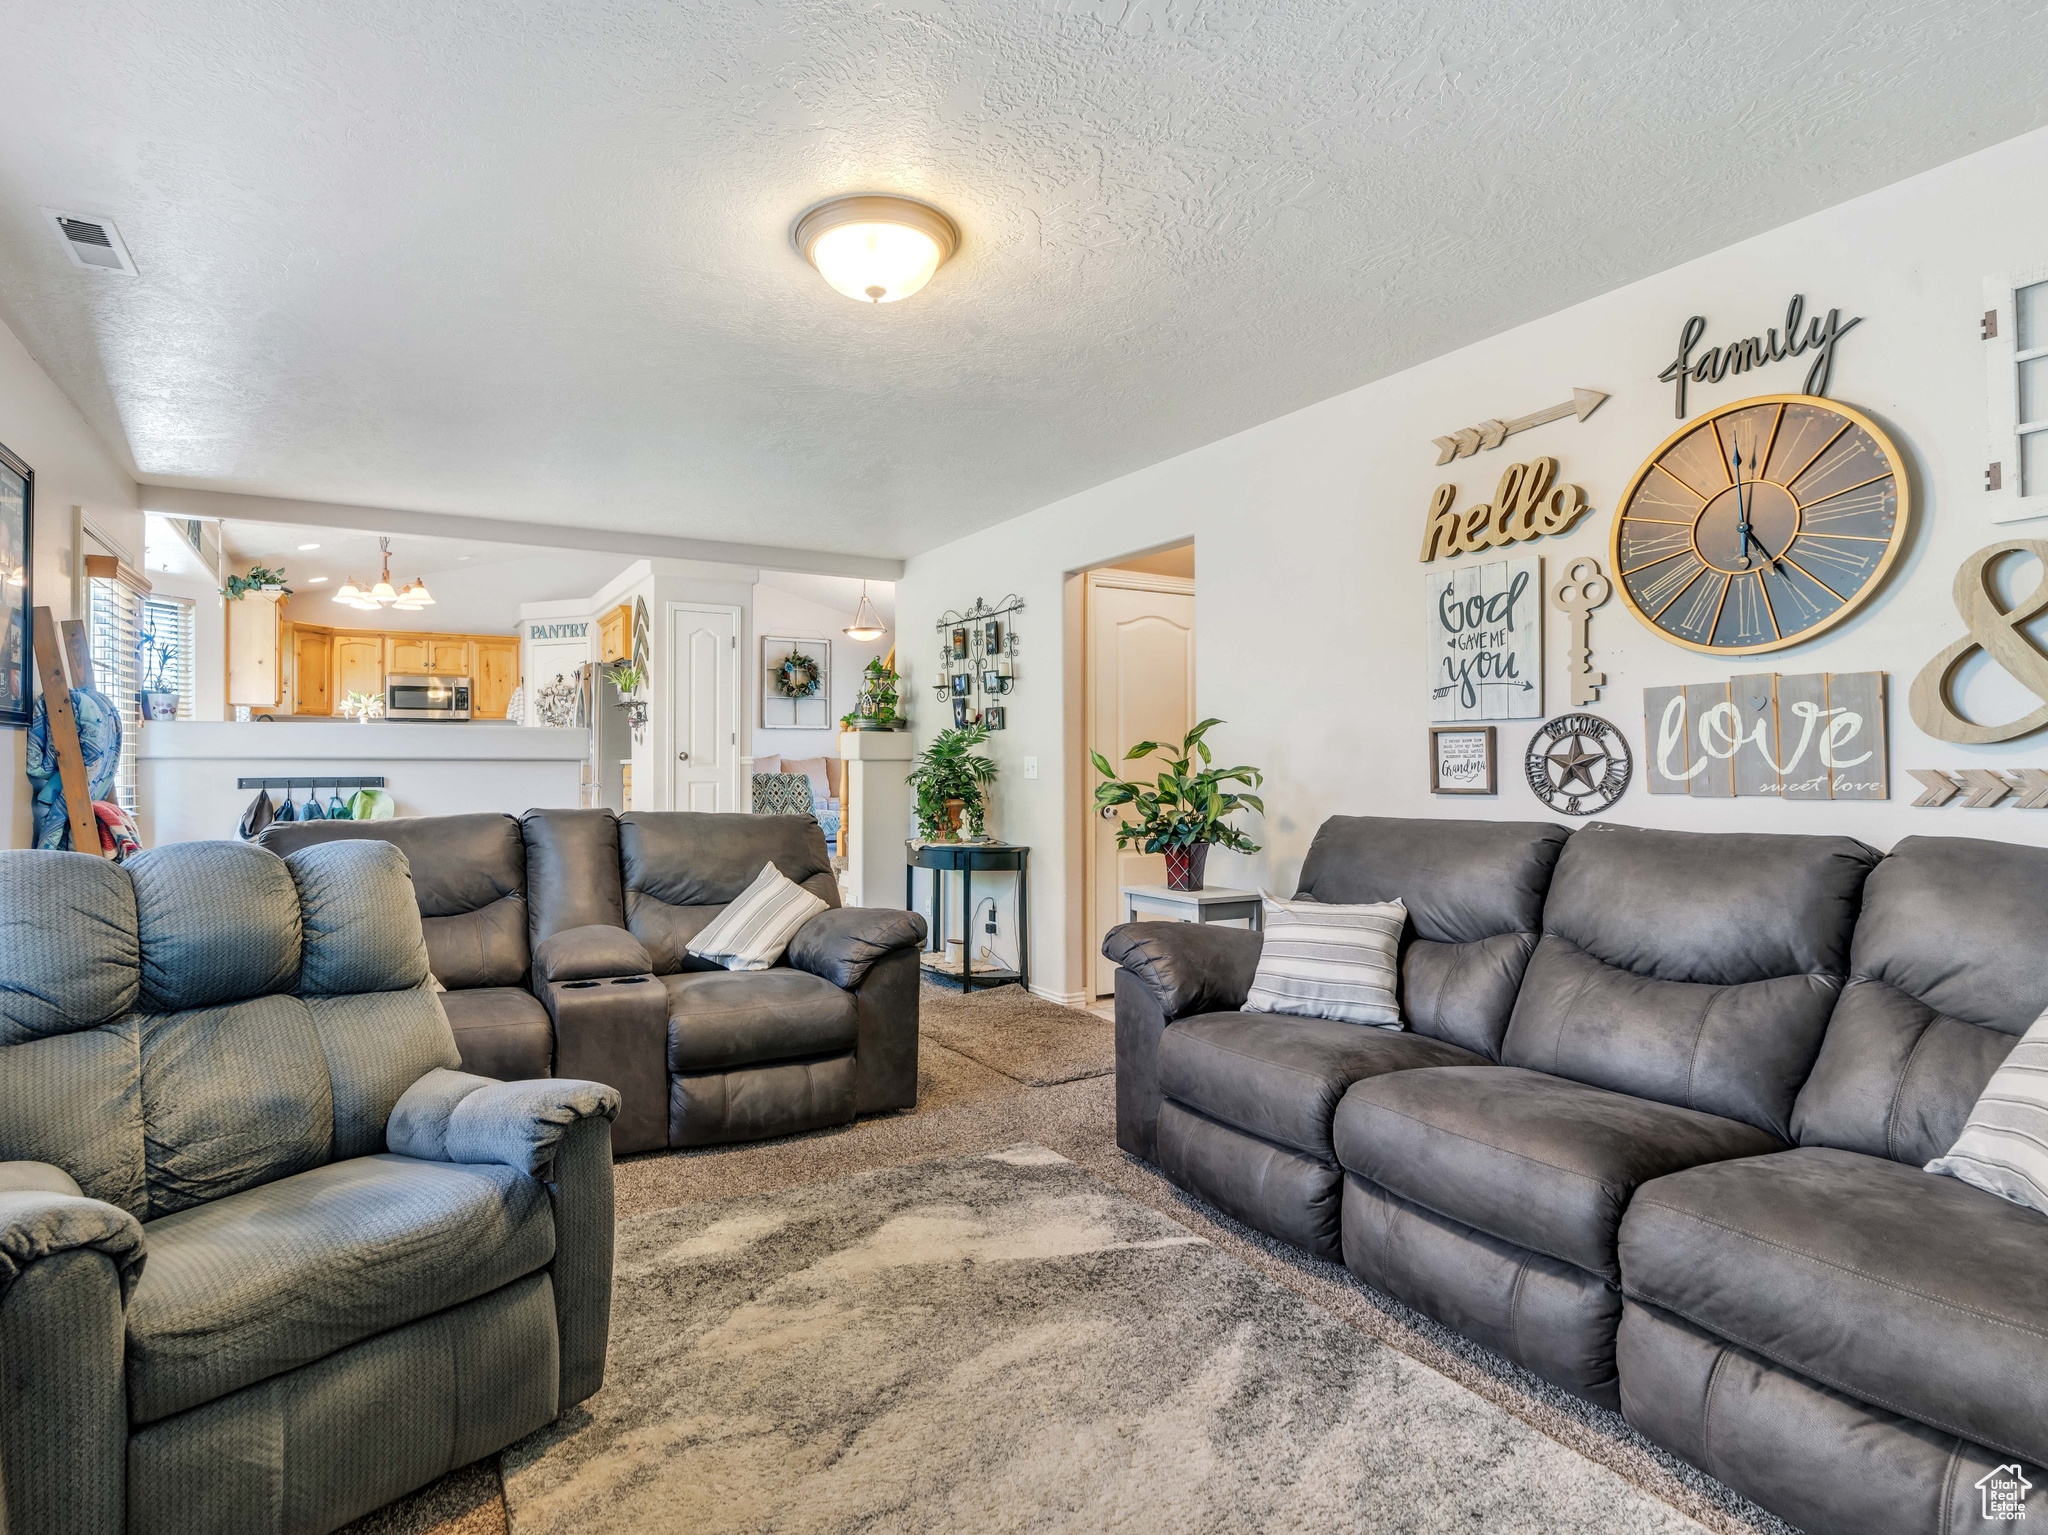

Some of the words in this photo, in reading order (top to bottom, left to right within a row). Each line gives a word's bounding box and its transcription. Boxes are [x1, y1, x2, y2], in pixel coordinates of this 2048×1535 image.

[1657, 293, 1863, 420] family
[1419, 456, 1588, 562] hello
[1439, 571, 1530, 634] God
[529, 622, 590, 640] PANTRY
[1458, 631, 1488, 651] GAVE
[1490, 627, 1507, 649] ME
[1442, 651, 1520, 709] you
[1543, 716, 1609, 741] WELCOME
[1656, 694, 1873, 782] love
[1442, 758, 1486, 778] Grandma
[1526, 753, 1558, 802] FRIENDS
[1758, 775, 1829, 793] sweet
